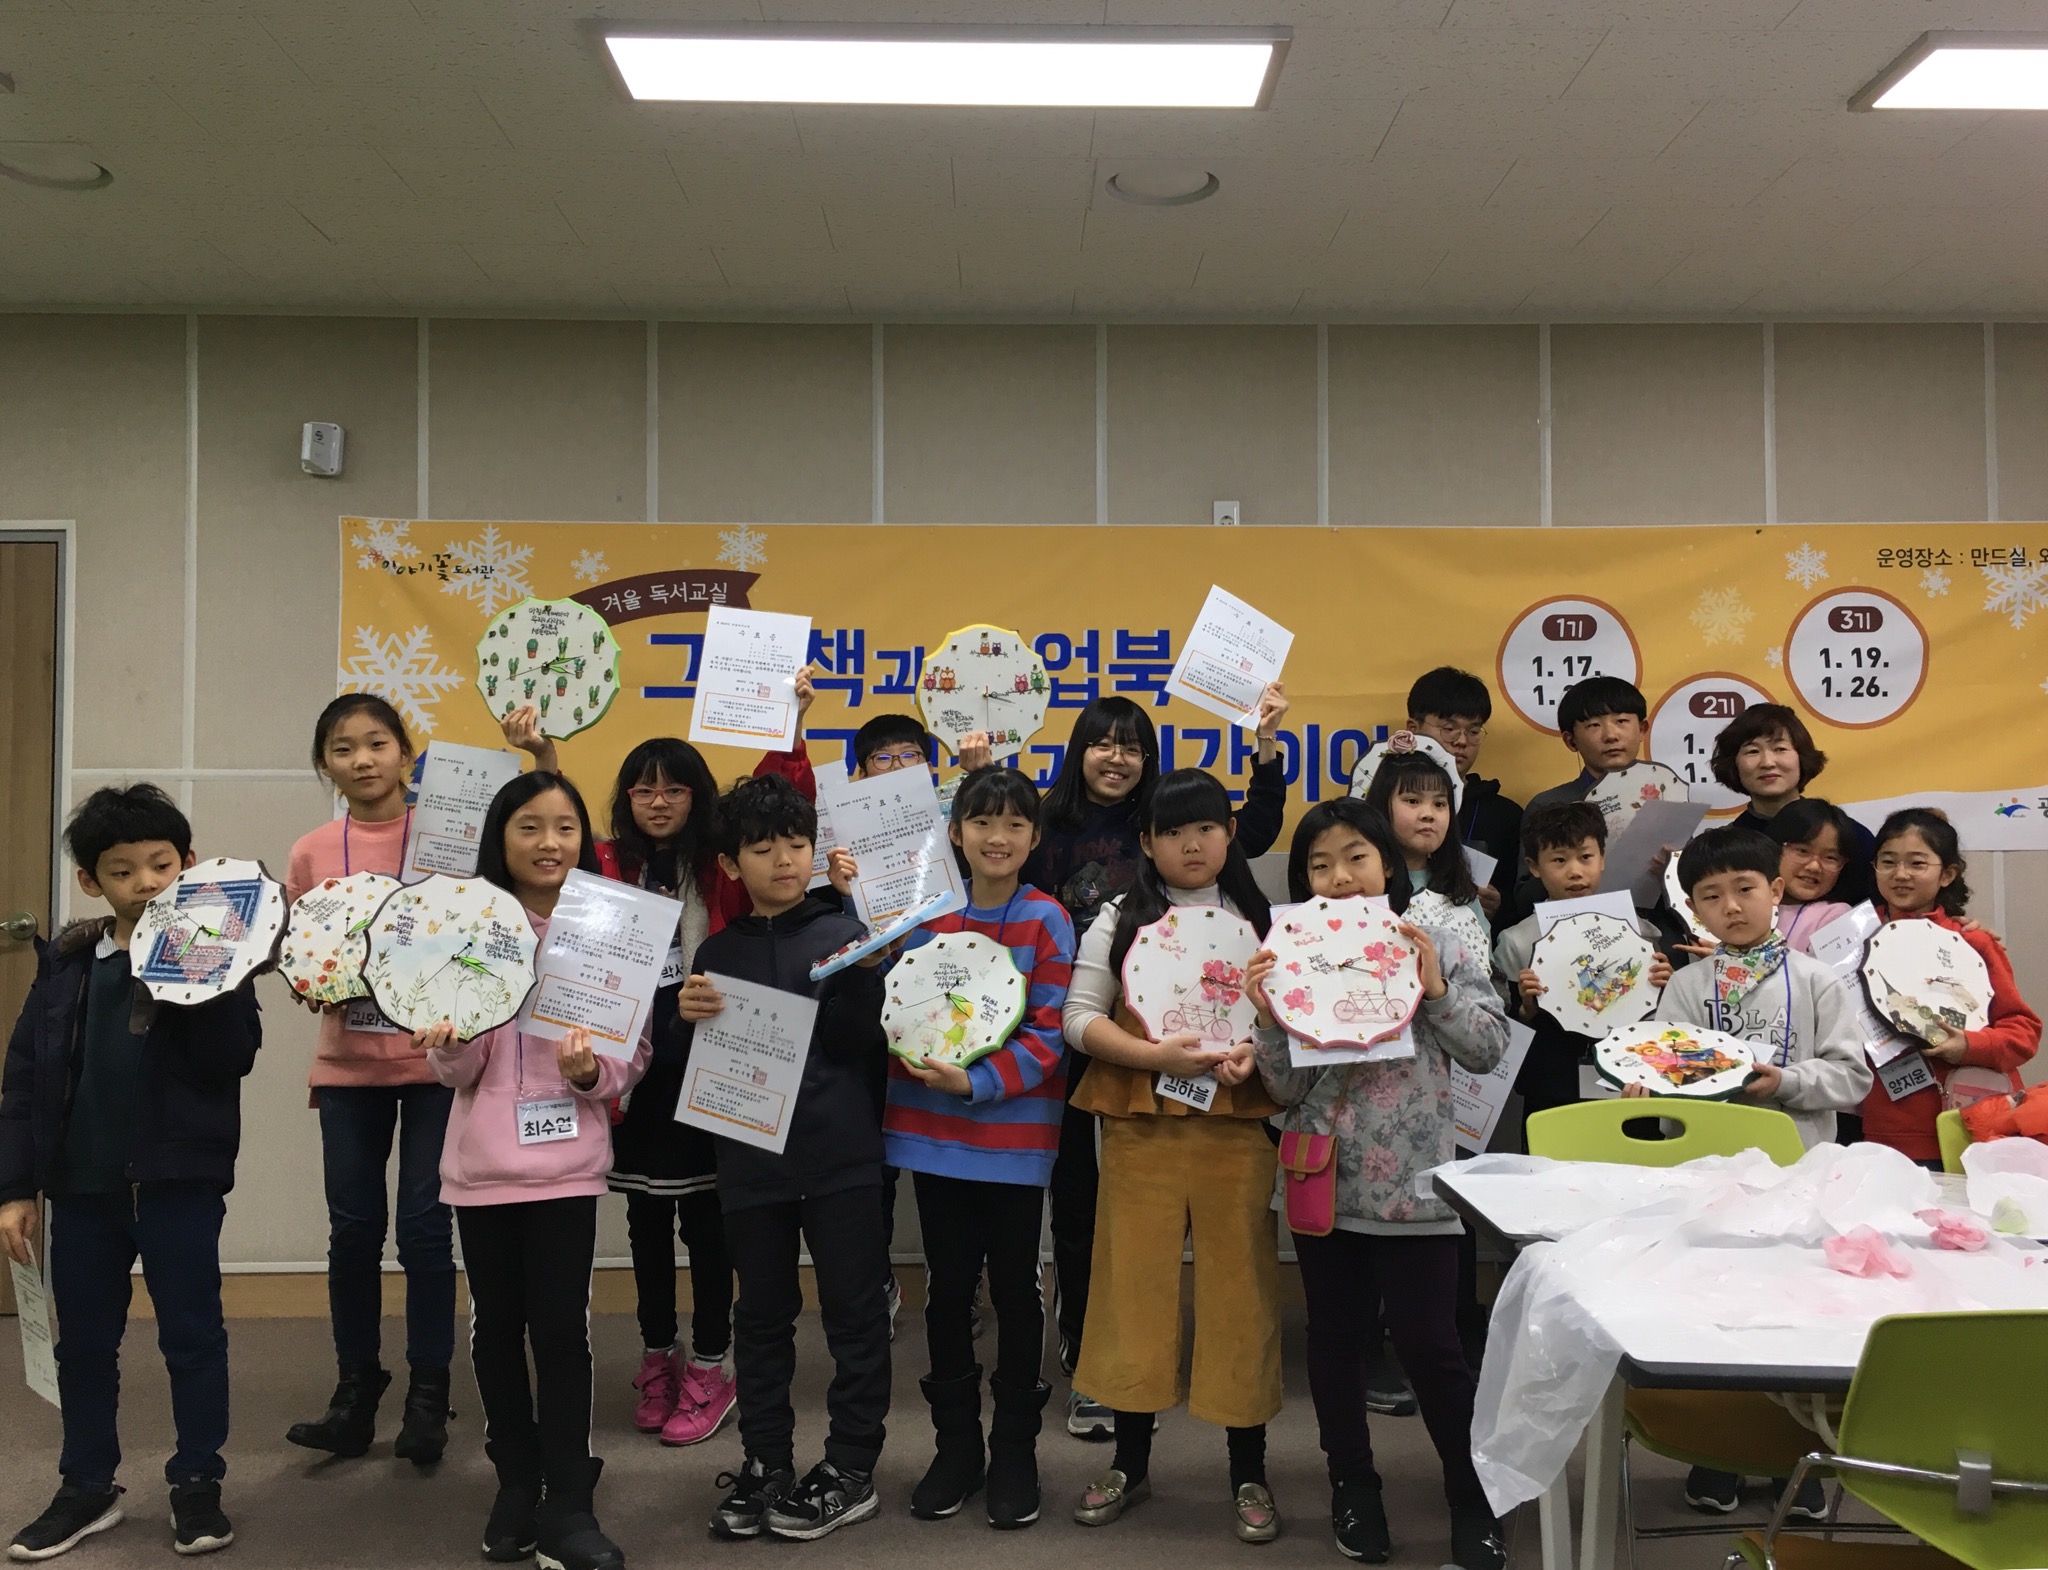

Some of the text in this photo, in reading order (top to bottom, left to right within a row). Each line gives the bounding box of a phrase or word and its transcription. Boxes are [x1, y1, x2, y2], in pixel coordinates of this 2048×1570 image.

[1876, 548, 1953, 568] 운영장소
[1971, 547, 2032, 567] 만드실,
[453, 565, 495, 580] 도서관
[601, 582, 728, 613] 겨울 독서교실
[1840, 609, 1871, 630] 3기
[1703, 696, 1735, 716] 2기
[1888, 1068, 1927, 1094] 양지윤
[524, 1116, 573, 1137] 최수연
